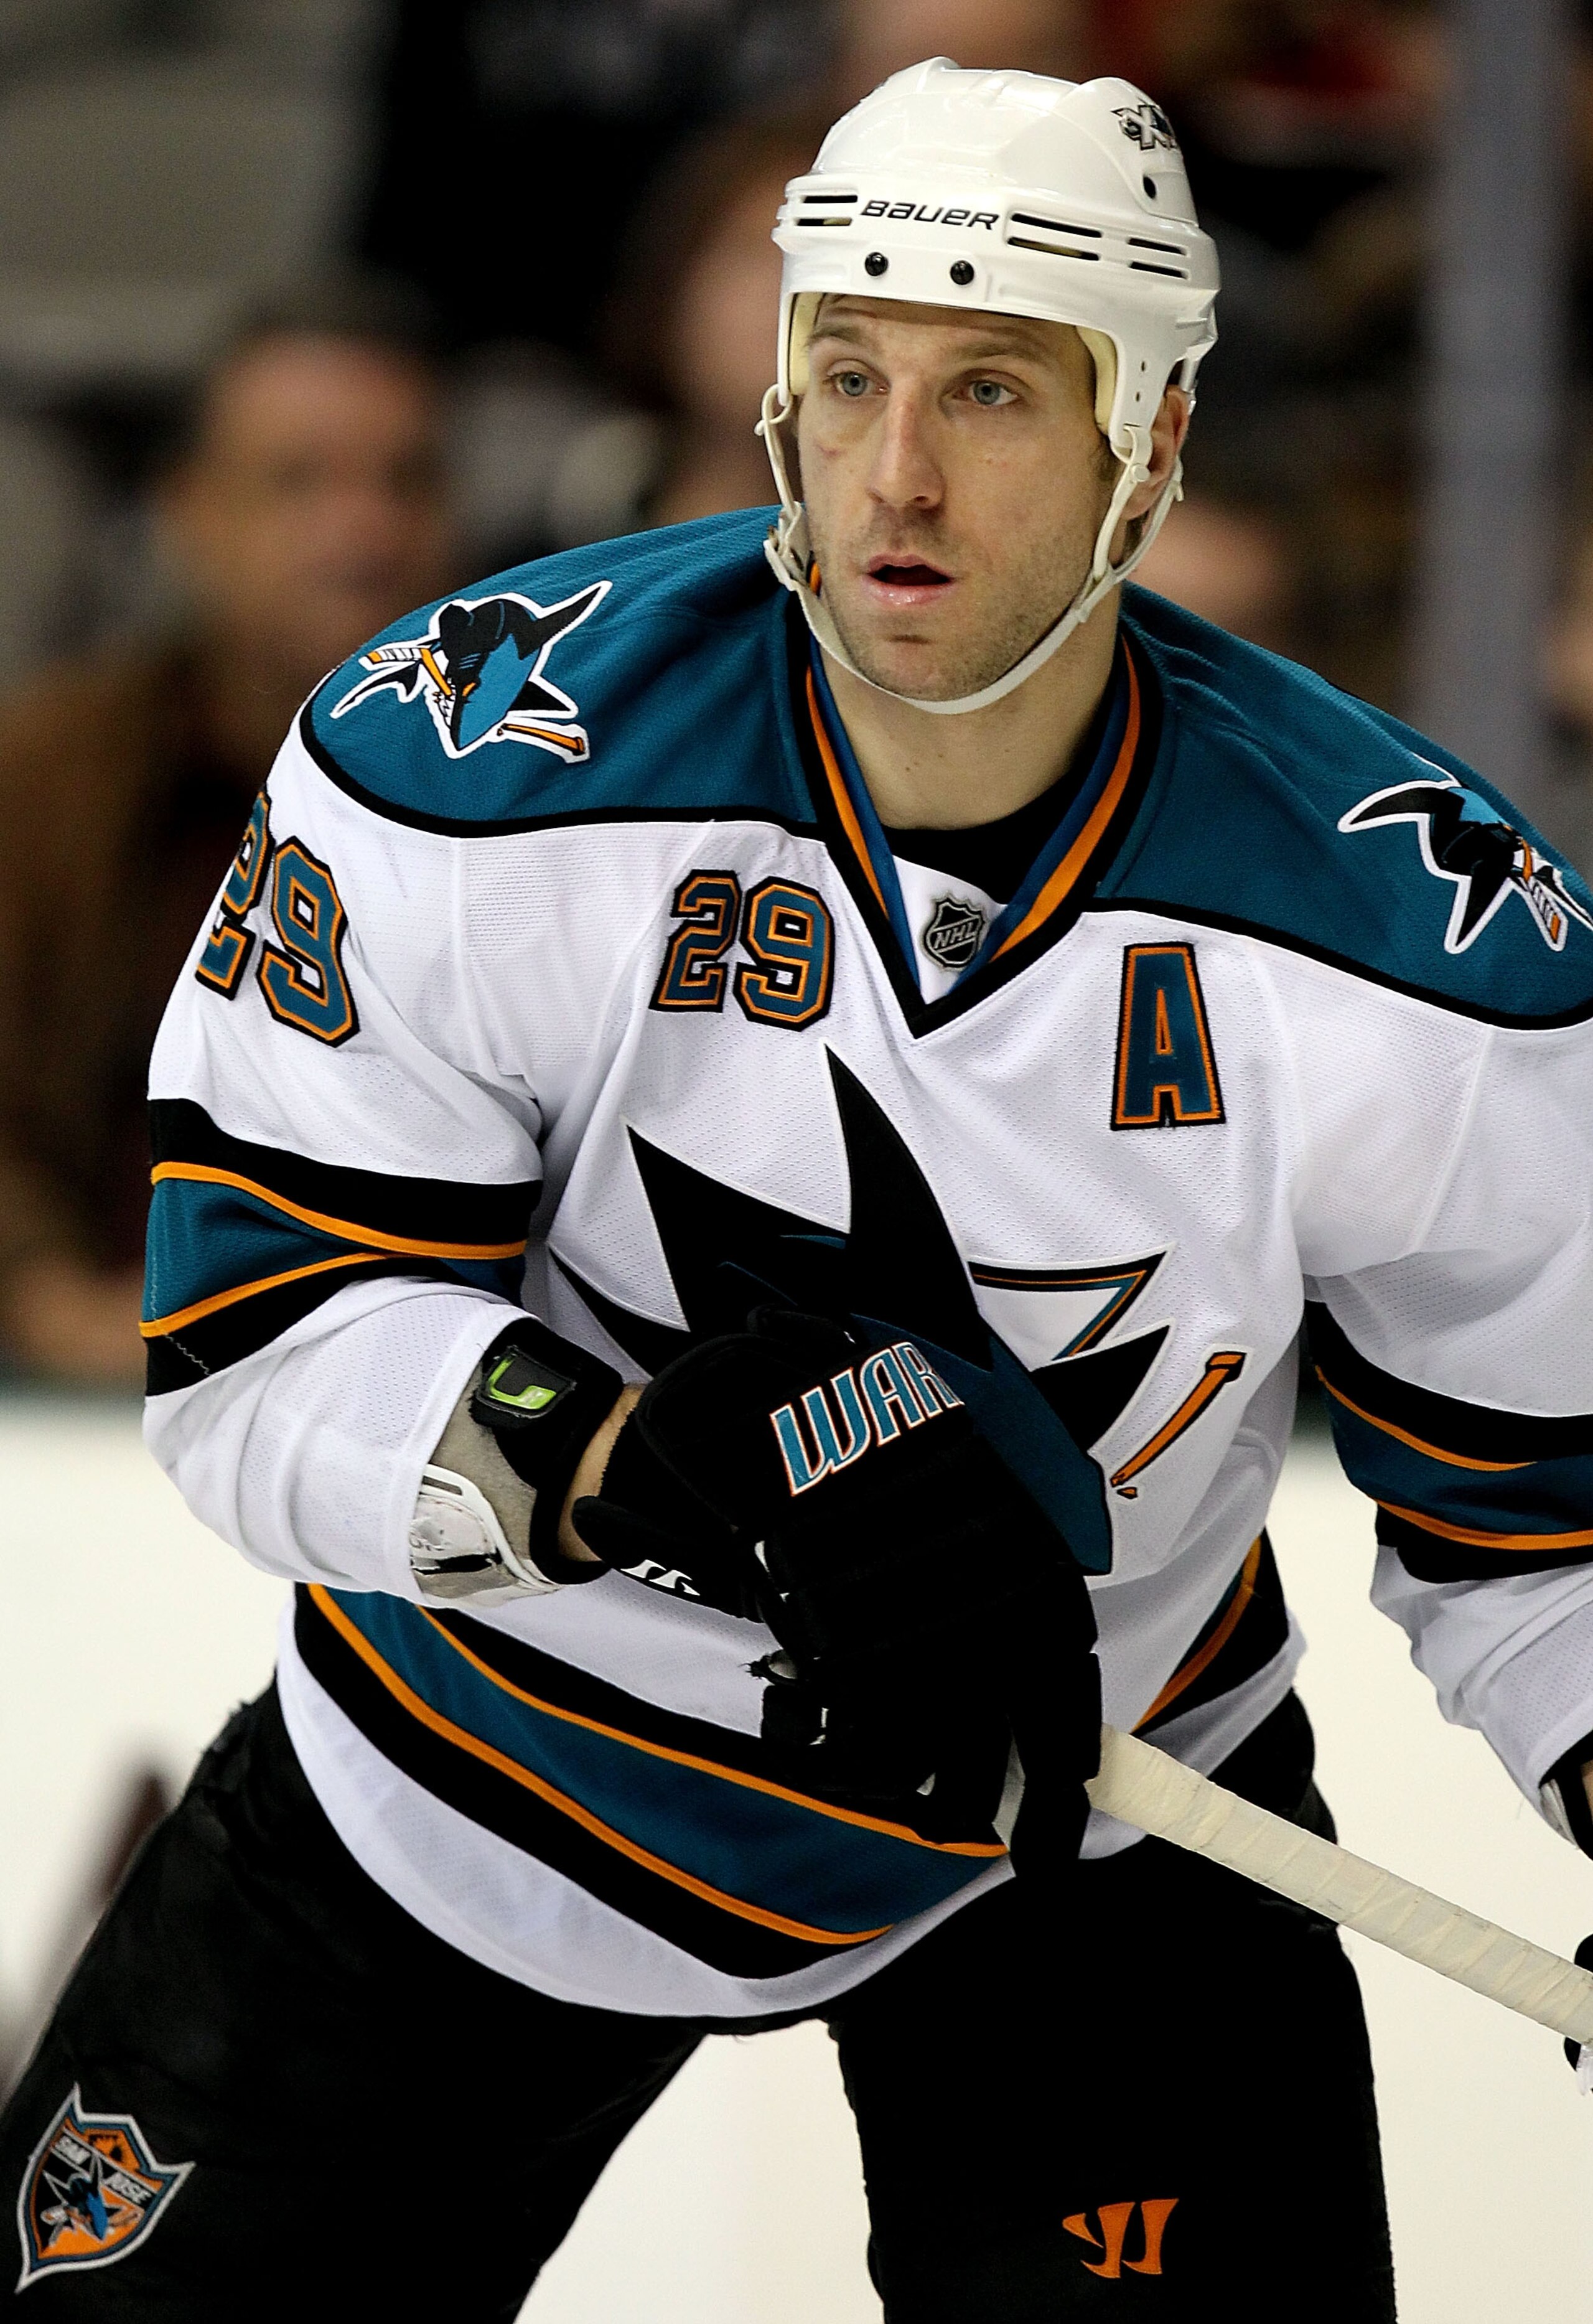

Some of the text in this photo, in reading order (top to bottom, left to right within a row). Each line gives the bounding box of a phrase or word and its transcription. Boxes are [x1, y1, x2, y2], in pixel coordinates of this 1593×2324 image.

[860, 200, 999, 230] BAUER
[195, 783, 362, 1048] 29
[648, 869, 834, 1032] 29
[933, 922, 977, 949] NHL
[1110, 941, 1226, 1132] A
